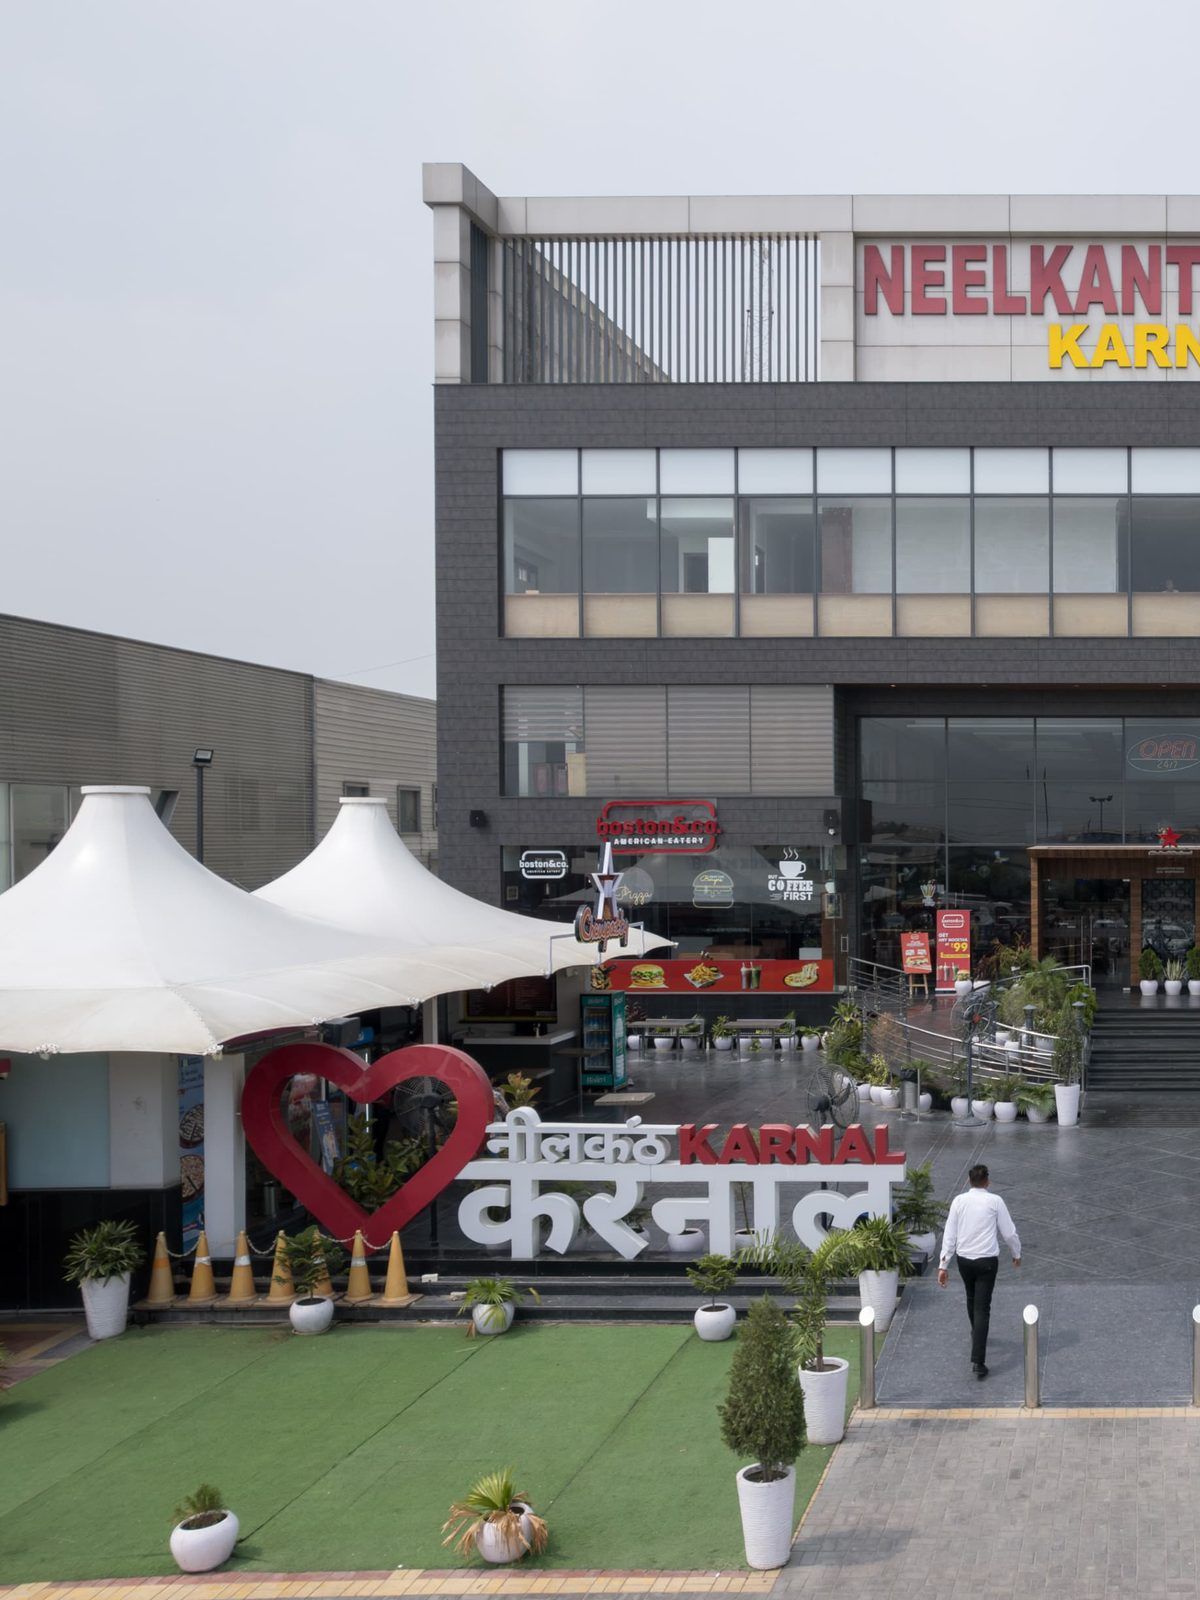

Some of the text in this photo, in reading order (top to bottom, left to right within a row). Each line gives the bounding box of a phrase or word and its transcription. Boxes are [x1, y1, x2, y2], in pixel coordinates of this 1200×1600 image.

[596, 815, 723, 836] boston&co.
[613, 837, 705, 846] AMERICAN EATERY
[519, 859, 569, 868] boston&co.
[767, 879, 814, 891] COFFEE
[783, 891, 814, 901] FIRST
[678, 1123, 907, 1165] KARNAL
